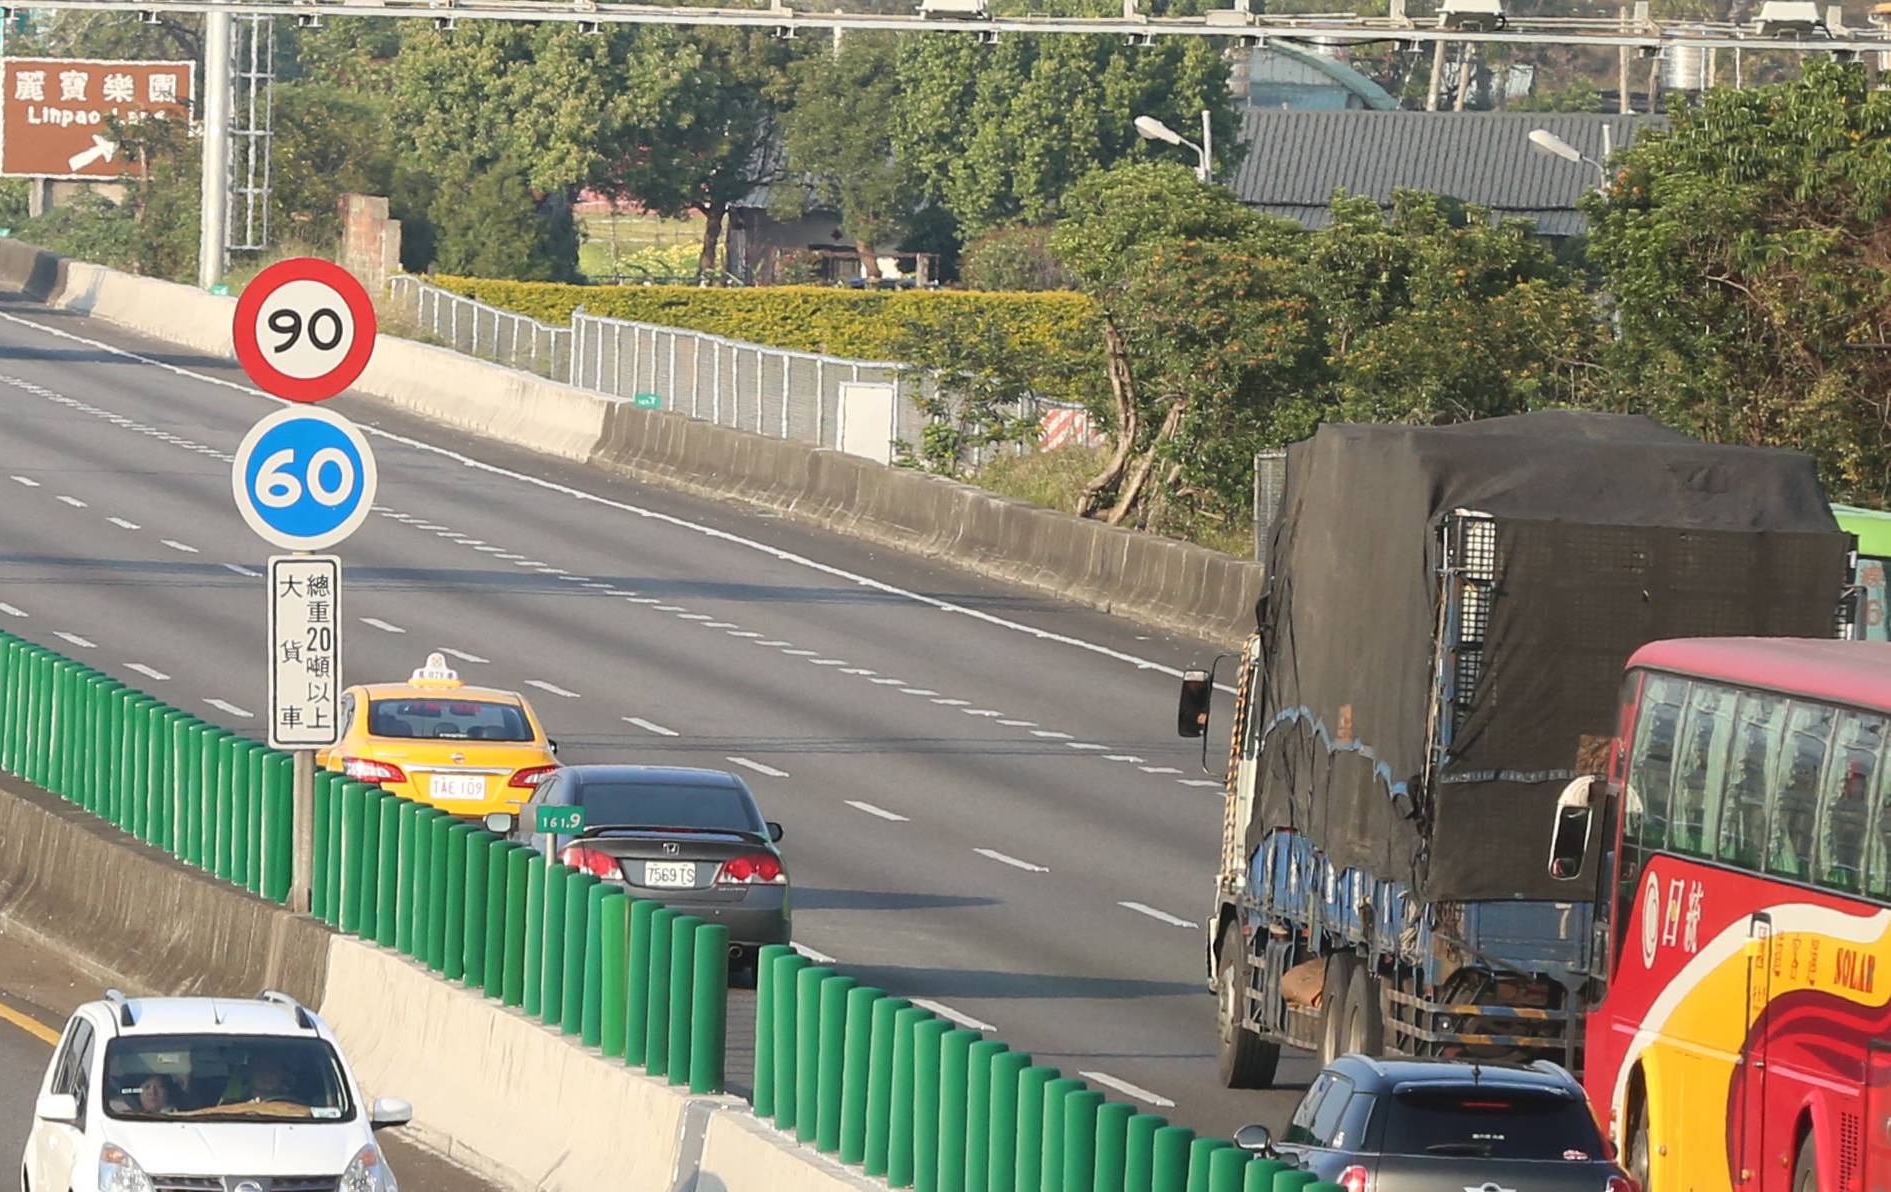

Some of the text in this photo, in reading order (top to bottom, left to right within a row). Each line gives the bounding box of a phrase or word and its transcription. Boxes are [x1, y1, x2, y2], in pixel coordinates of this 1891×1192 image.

[14, 70, 178, 104] 麗寶樂園
[28, 106, 101, 128] Linpao
[268, 308, 344, 354] 90
[255, 447, 355, 509] 60
[279, 574, 304, 730] 大貨車
[306, 574, 331, 730] 總重20噸以上
[542, 811, 581, 829] 161.9
[1834, 947, 1876, 993] SOLAR
